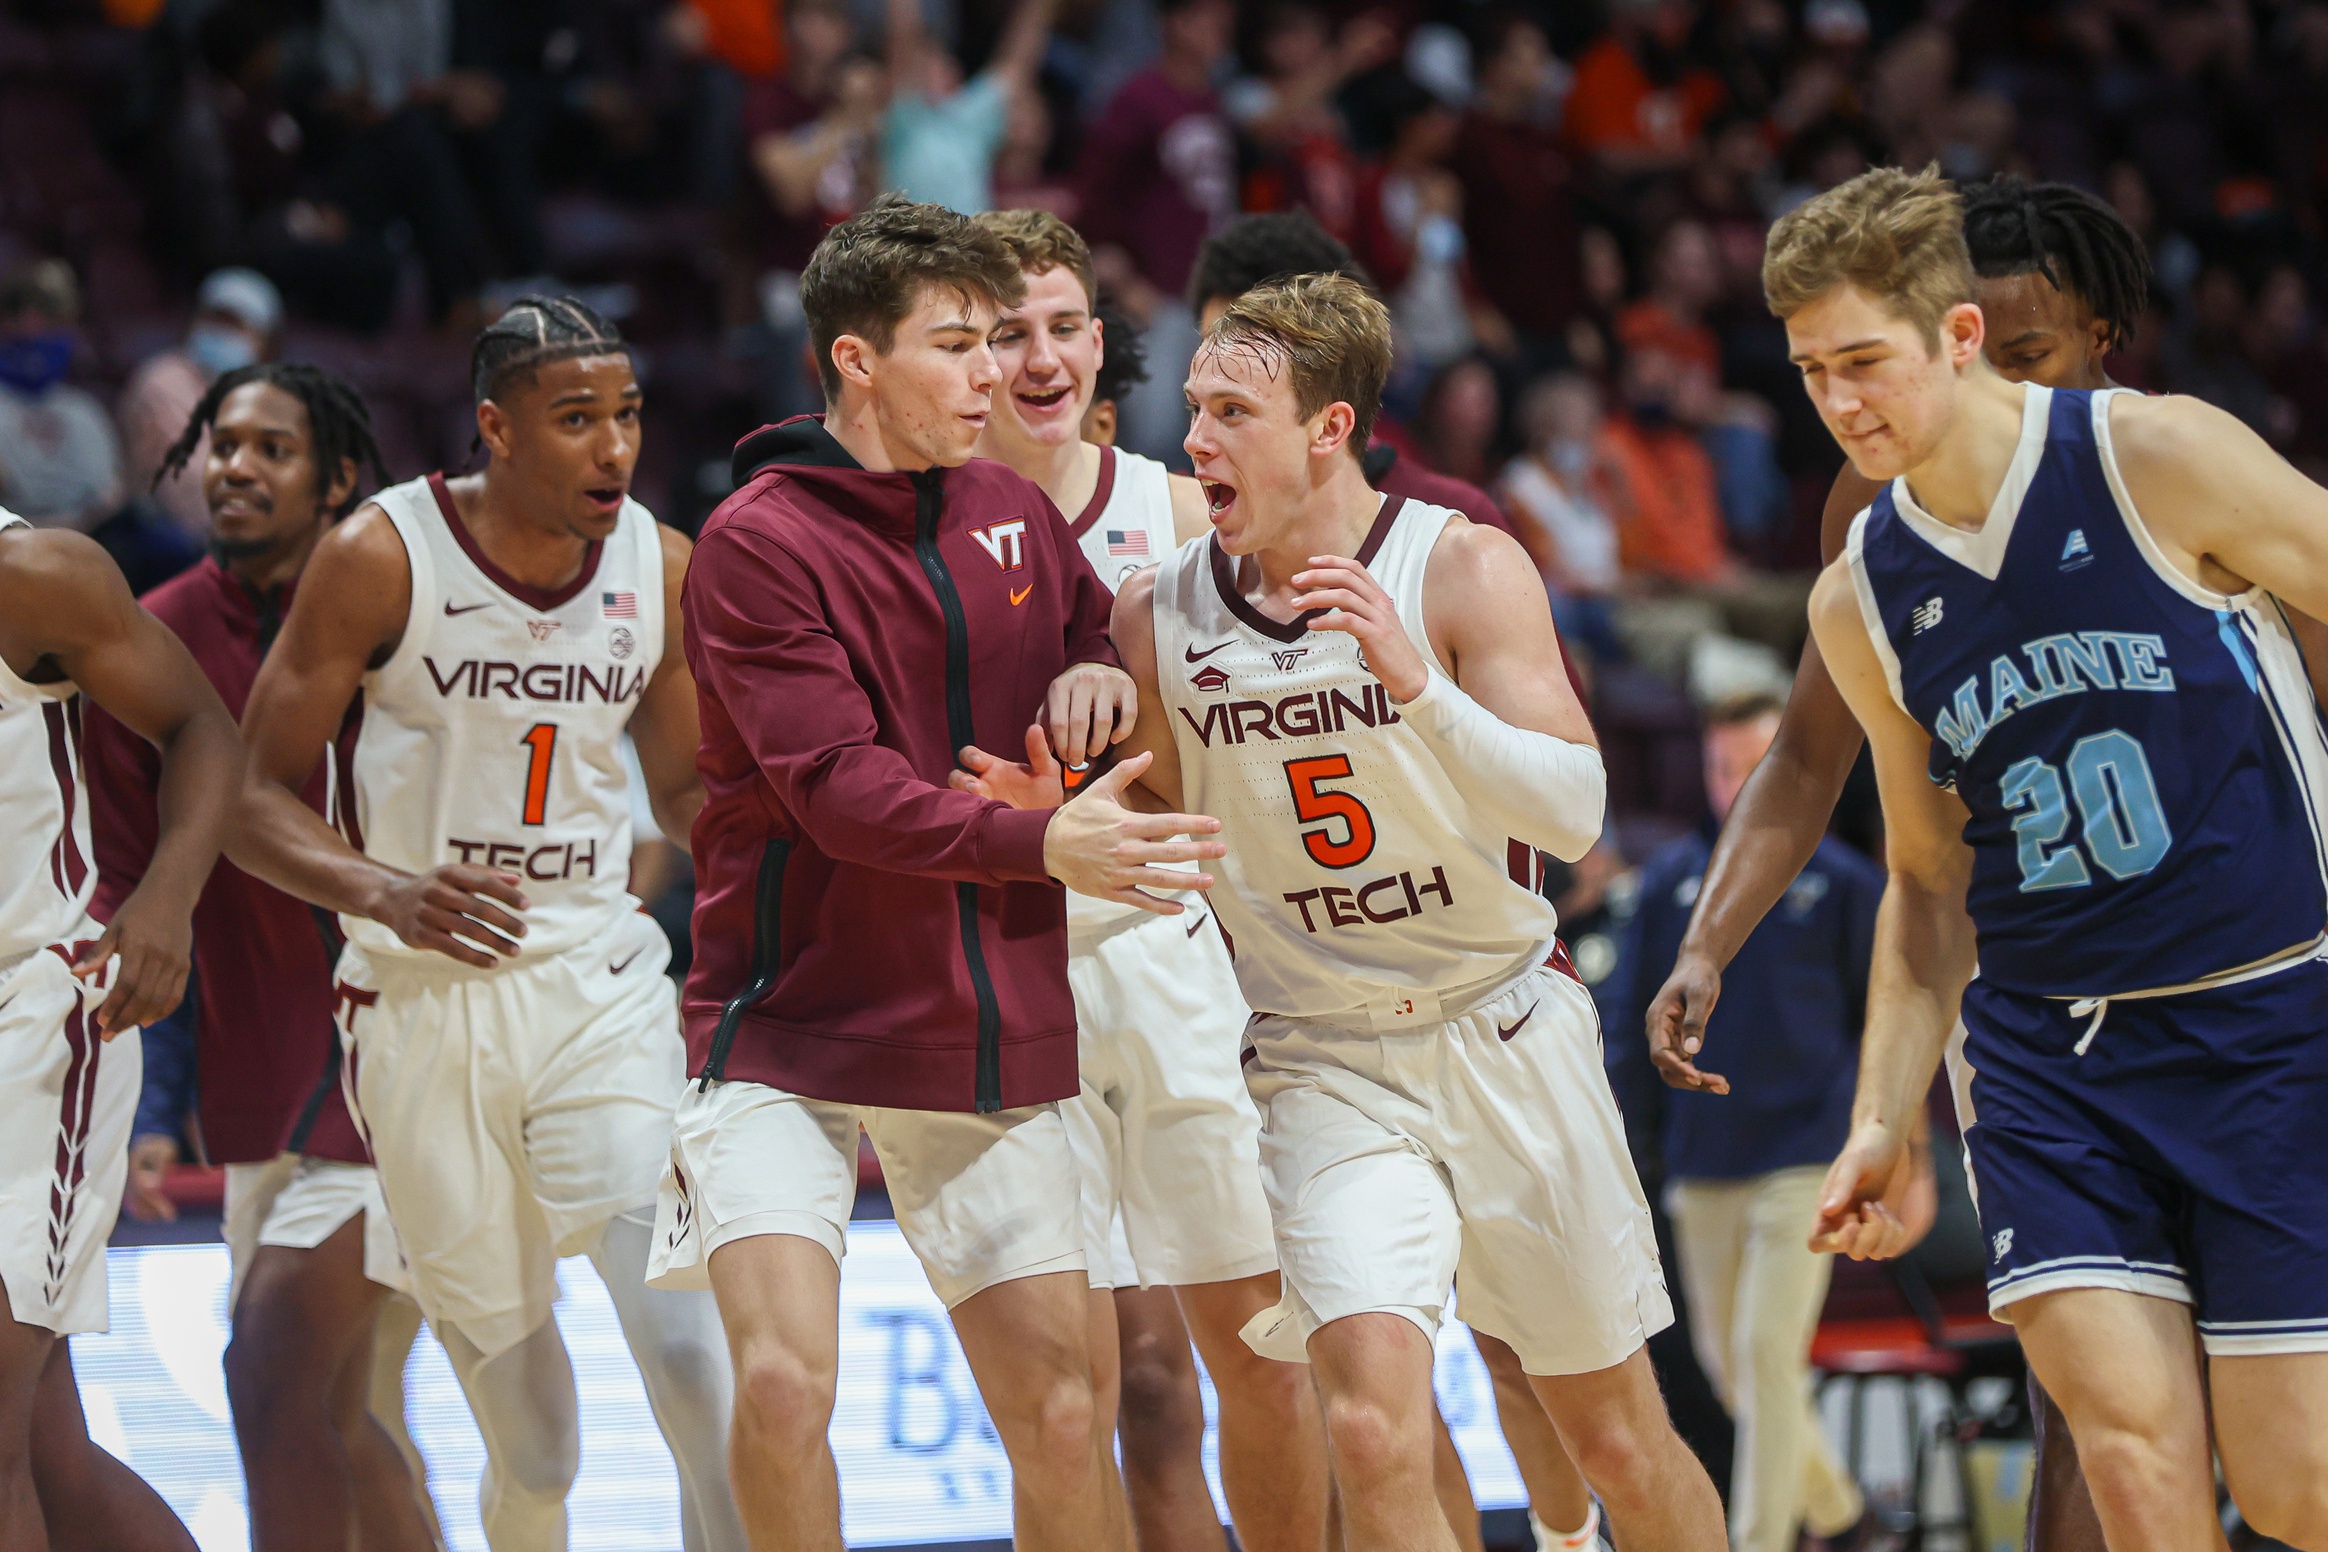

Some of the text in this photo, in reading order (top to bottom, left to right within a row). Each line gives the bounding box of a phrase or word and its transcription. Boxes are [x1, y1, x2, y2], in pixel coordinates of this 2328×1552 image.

[968, 515, 1028, 574] VT
[1271, 648, 1308, 671] VT
[1177, 683, 1402, 749] VIRGINI
[1935, 631, 2176, 762] MAINE
[519, 722, 558, 827] 1
[1282, 752, 1376, 870] 5
[1999, 728, 2172, 892] 20
[448, 838, 596, 881] TECH
[1282, 865, 1454, 933] TECH
